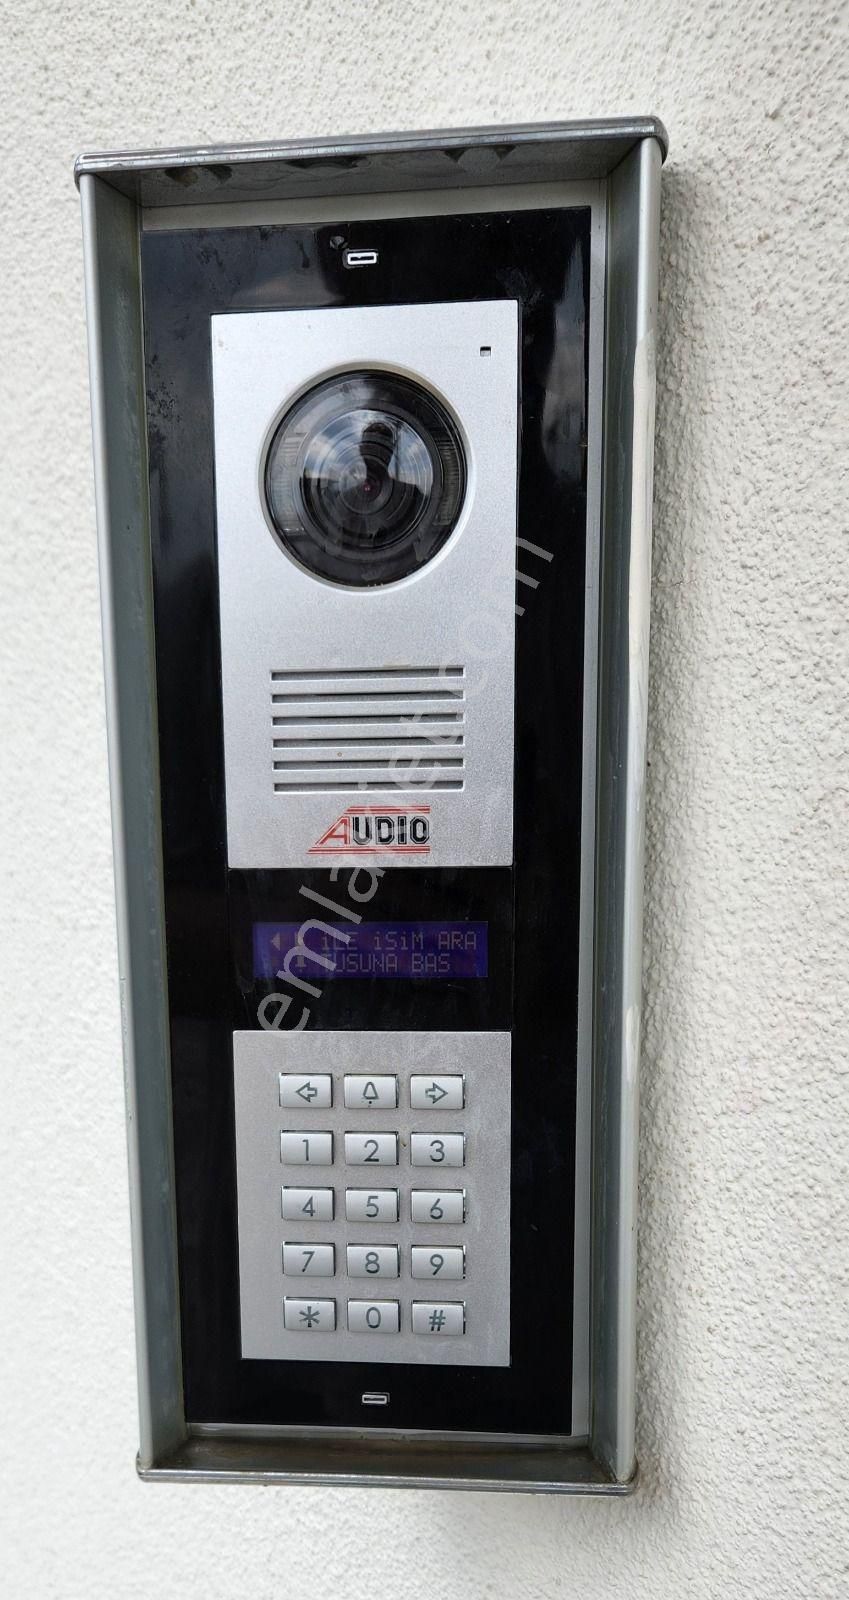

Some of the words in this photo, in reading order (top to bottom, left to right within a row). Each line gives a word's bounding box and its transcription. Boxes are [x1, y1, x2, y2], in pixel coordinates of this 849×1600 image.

[315, 815, 430, 845] AUDIO
[438, 931, 477, 950] ARA
[411, 953, 450, 973] BAS
[302, 1139, 310, 1161] 1
[363, 1139, 380, 1162] 2
[429, 1139, 446, 1162] 3
[302, 1195, 316, 1217] 4
[366, 1195, 379, 1218] 5
[429, 1198, 444, 1220] 6
[302, 1251, 316, 1273] 7
[365, 1251, 380, 1274] 8
[429, 1254, 444, 1275] 9
[366, 1306, 381, 1329] 0
[429, 1309, 446, 1332] #
